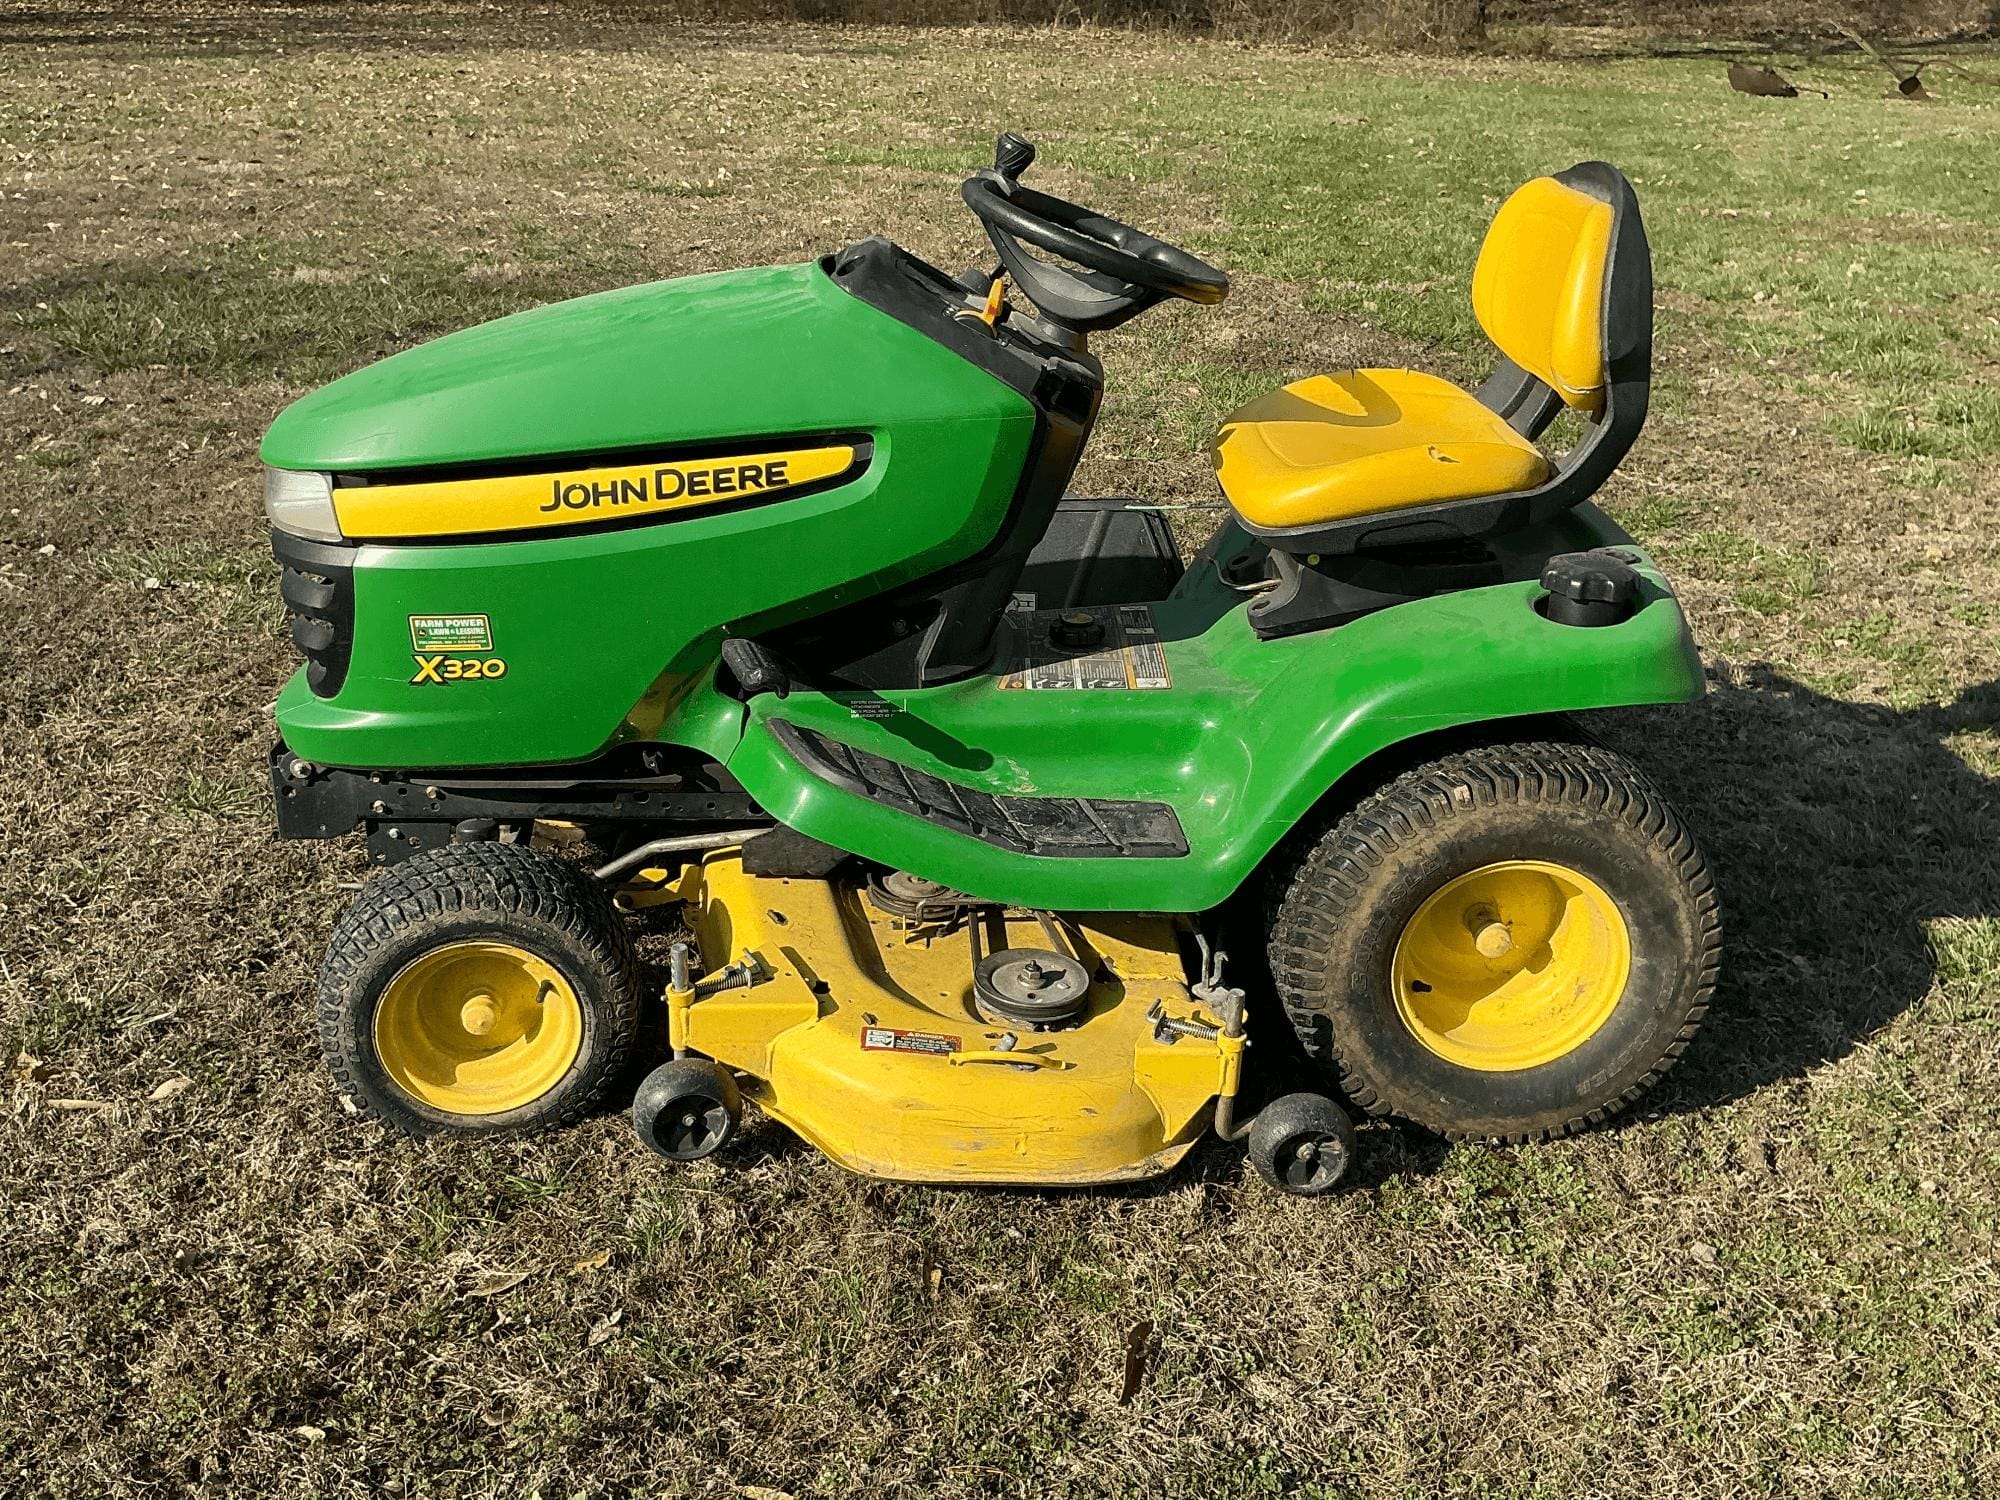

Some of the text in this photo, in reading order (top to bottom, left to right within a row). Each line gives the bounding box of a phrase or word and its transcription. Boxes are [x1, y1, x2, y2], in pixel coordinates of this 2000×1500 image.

[539, 460, 789, 512] JOHN DEERE
[415, 618, 484, 628] FARM POWER
[410, 655, 507, 684] X320
